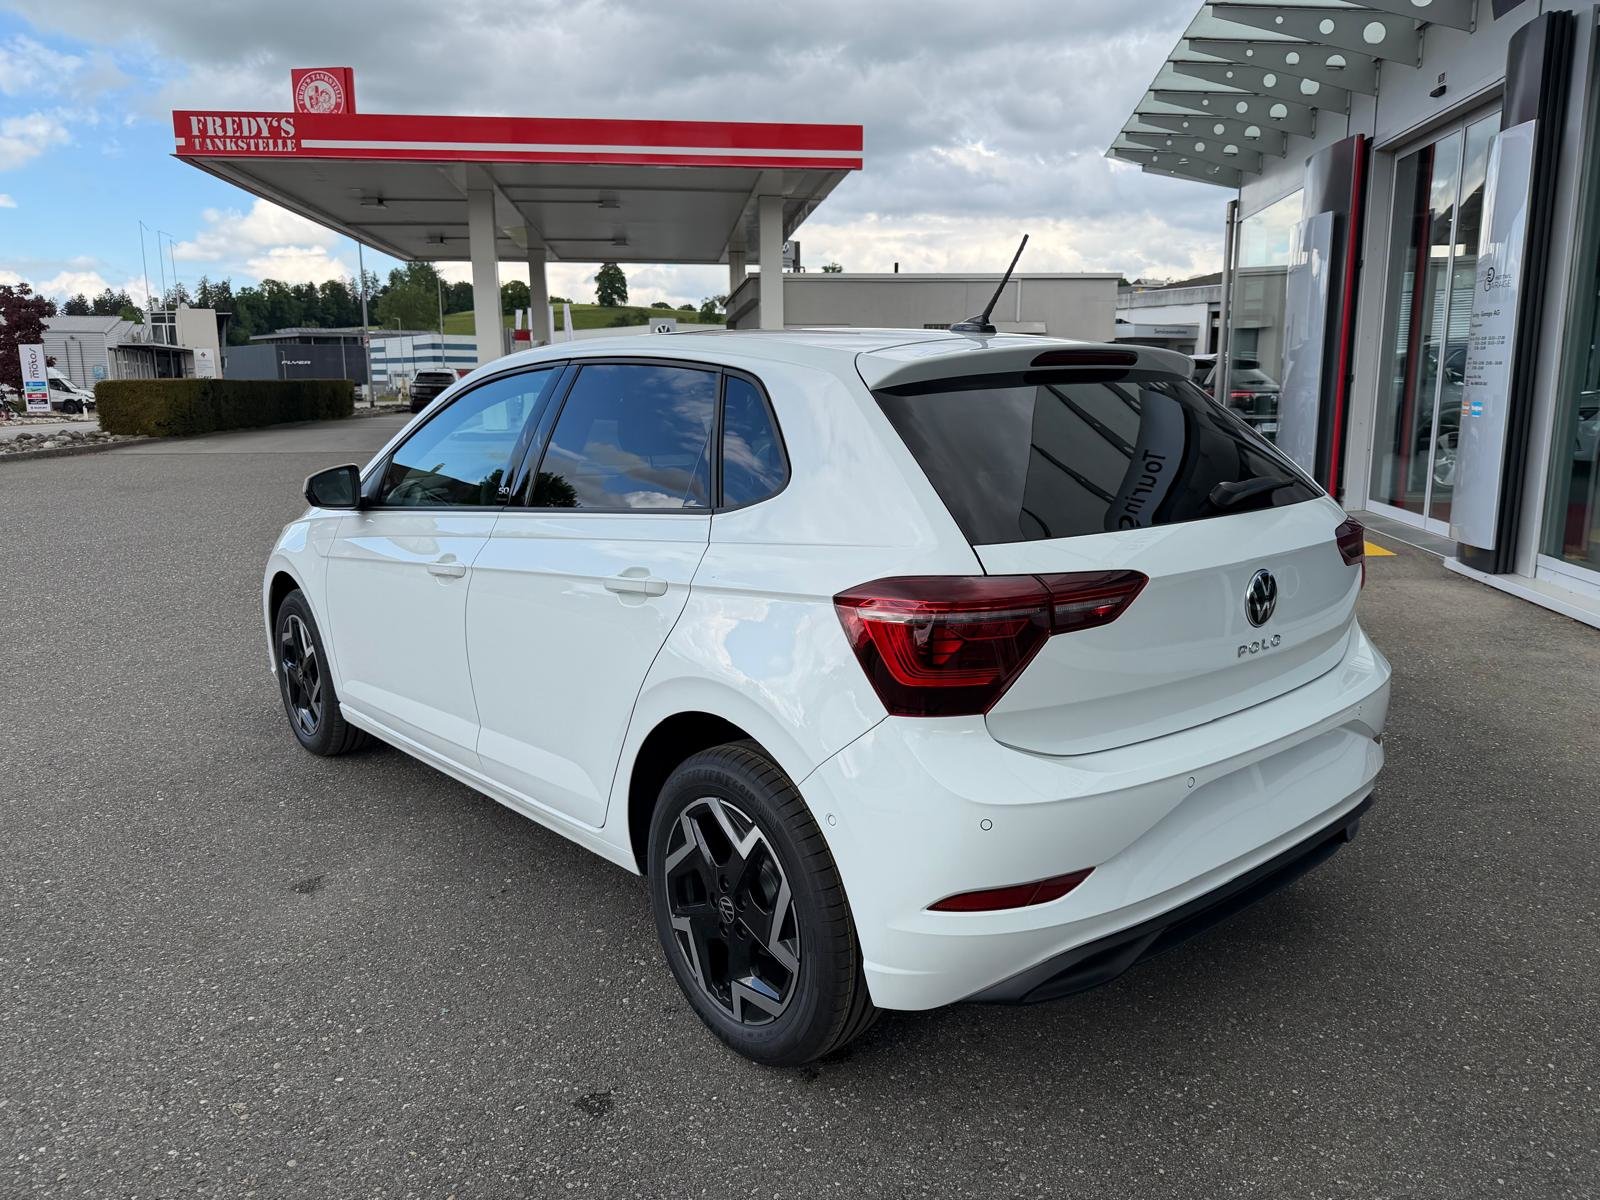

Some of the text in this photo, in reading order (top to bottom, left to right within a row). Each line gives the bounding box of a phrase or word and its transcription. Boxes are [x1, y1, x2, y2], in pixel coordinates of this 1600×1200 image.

[189, 116, 295, 138] FREDY'S
[192, 138, 297, 152] TANKSTELLE
[1237, 634, 1281, 658] POLO
